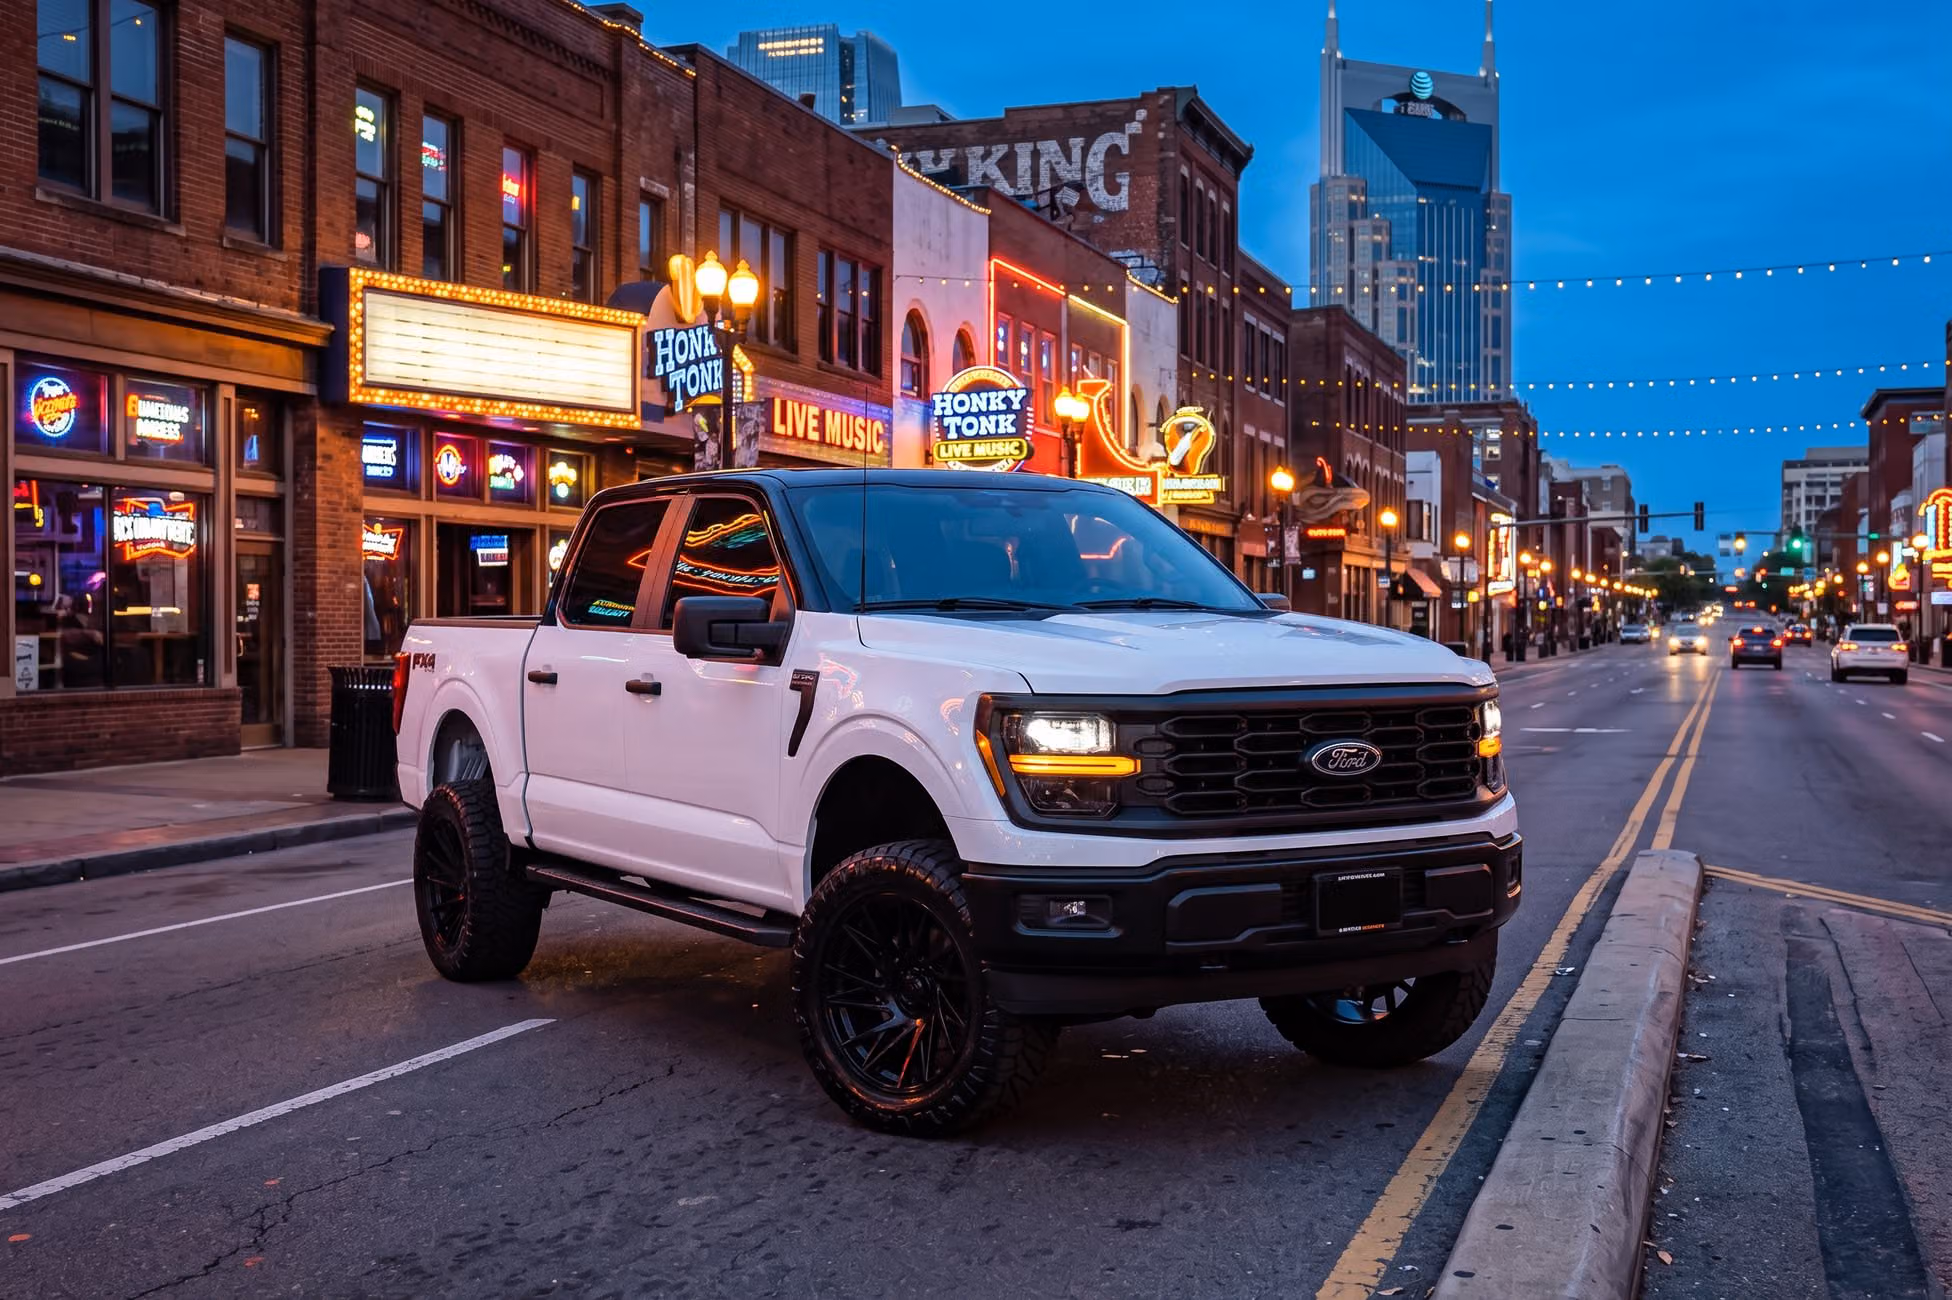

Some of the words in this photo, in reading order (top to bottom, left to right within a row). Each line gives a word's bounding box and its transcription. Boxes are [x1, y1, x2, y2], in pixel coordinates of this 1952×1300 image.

[964, 131, 1130, 212] KING
[654, 325, 717, 377] HONK
[669, 358, 723, 412] TONK
[932, 389, 1027, 416] HONKY
[773, 397, 820, 441] LIVE
[824, 408, 884, 454] MUSIC
[943, 413, 1017, 440] TONK
[939, 443, 972, 458] LIVE
[973, 440, 1020, 457] MUSIC
[1328, 748, 1368, 769] Ford
